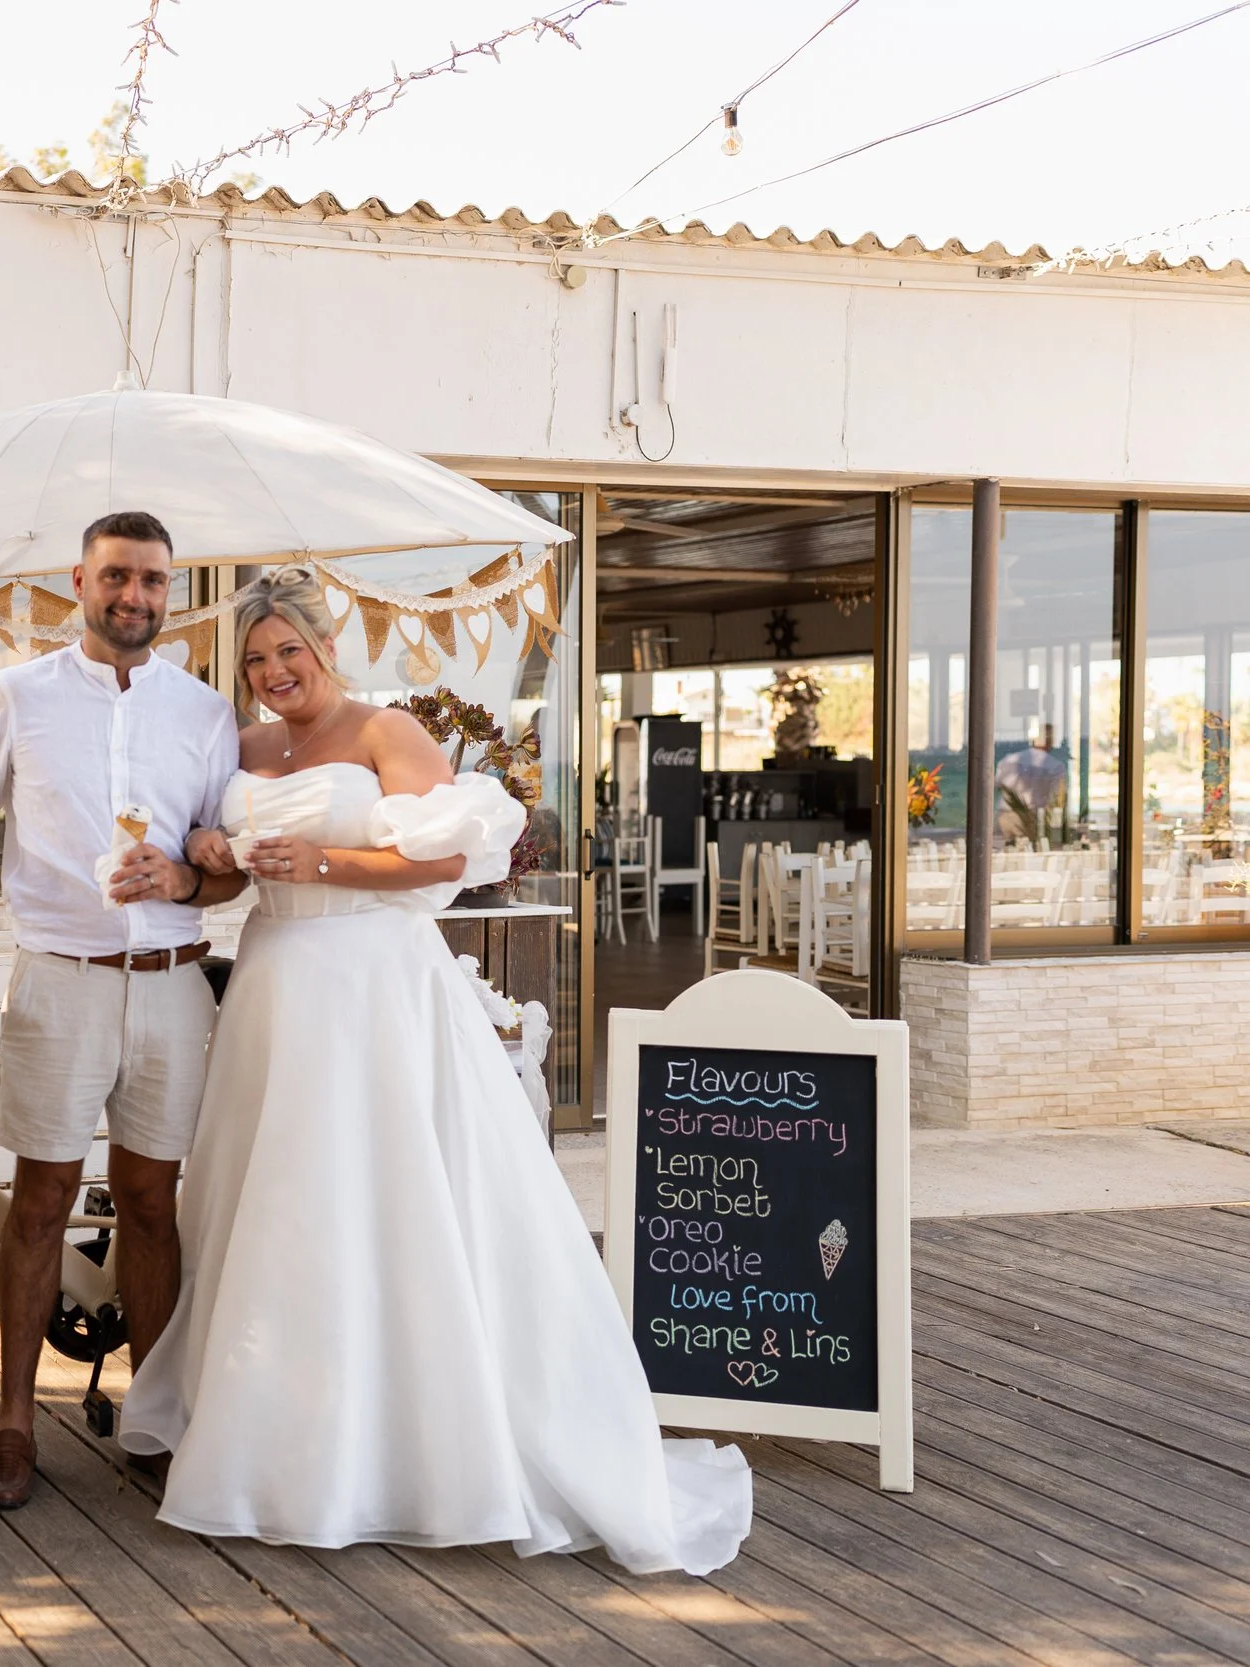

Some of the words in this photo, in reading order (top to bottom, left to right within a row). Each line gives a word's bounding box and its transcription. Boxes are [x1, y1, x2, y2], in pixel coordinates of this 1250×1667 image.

[666, 1058, 817, 1099] Flavours
[657, 1107, 847, 1157] Strawberry
[656, 1146, 764, 1189] Lemon
[656, 1181, 772, 1218] Sorbet
[741, 1285, 824, 1325] from
[650, 1317, 752, 1355] Shane
[761, 1328, 782, 1358] &
[790, 1328, 851, 1365] Lins
